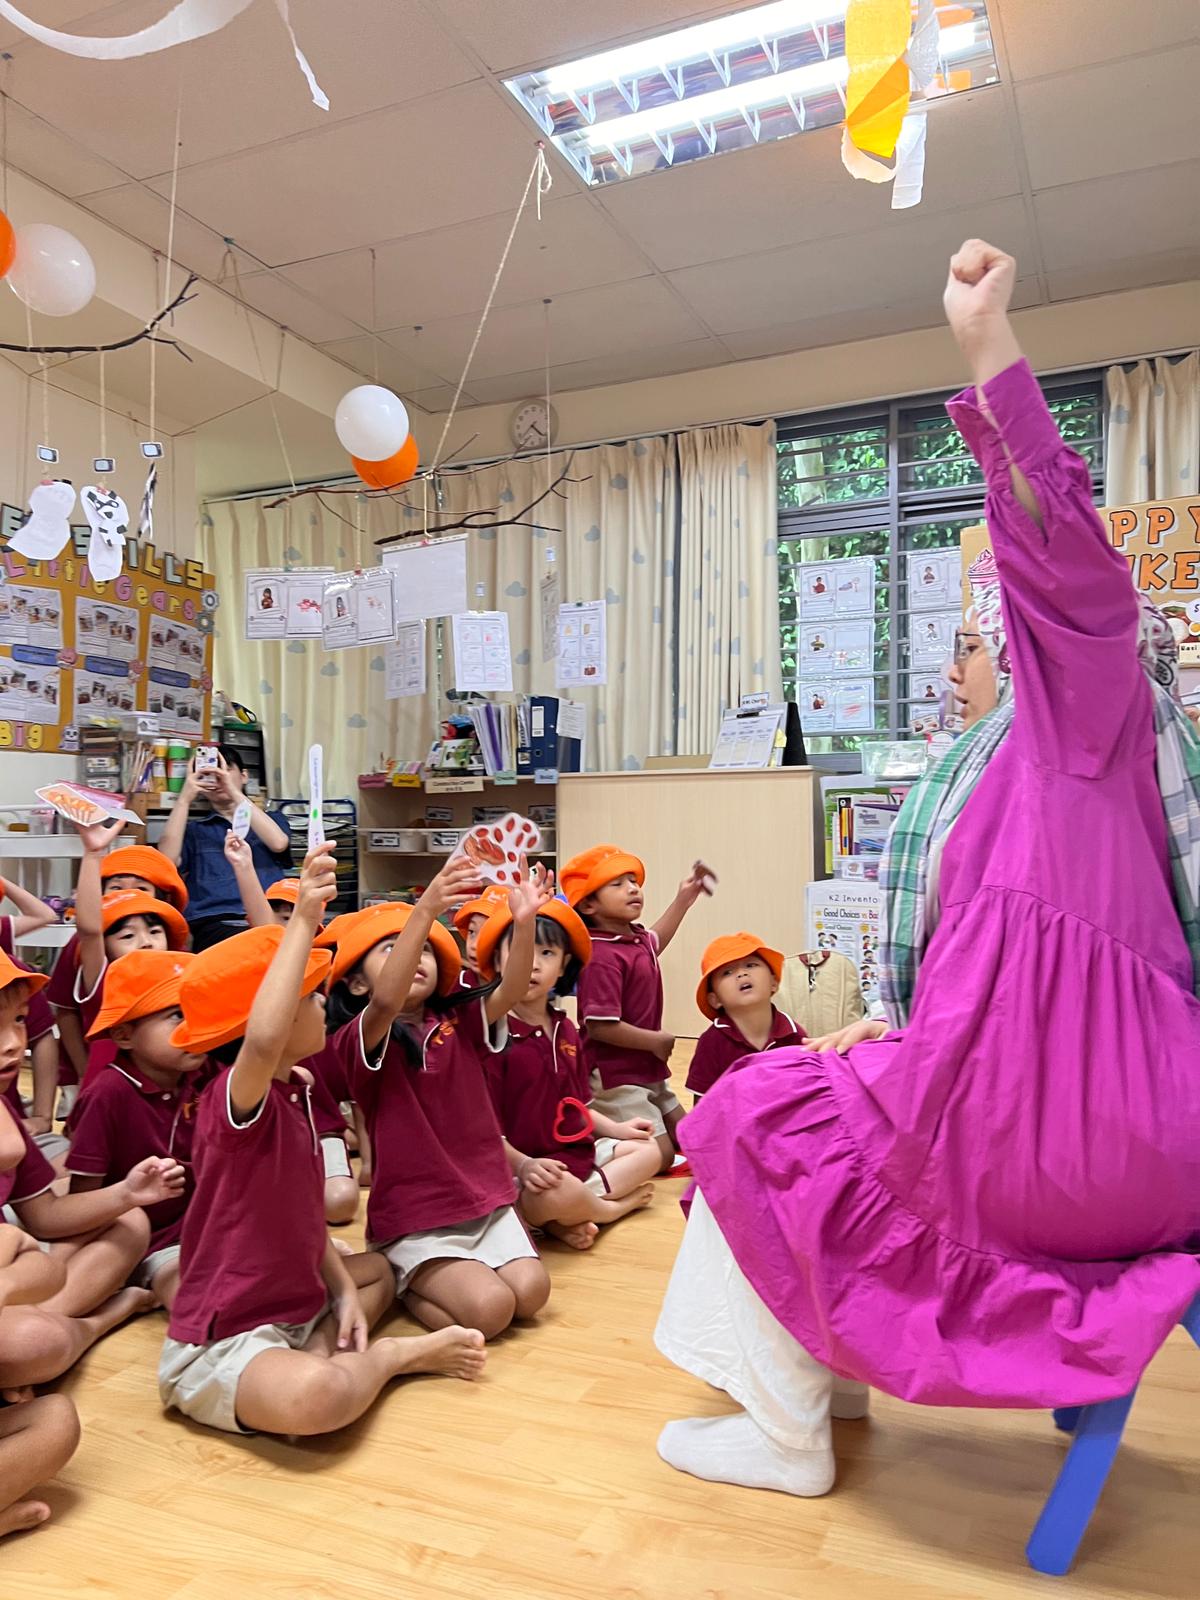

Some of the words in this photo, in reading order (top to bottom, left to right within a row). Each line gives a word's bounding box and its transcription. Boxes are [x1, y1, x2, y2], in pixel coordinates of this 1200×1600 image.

[70, 524, 204, 591] SILLS
[1122, 551, 1200, 591] KE
[843, 895, 880, 904] Invento
[824, 908, 838, 918] Good
[840, 908, 860, 918] Choices
